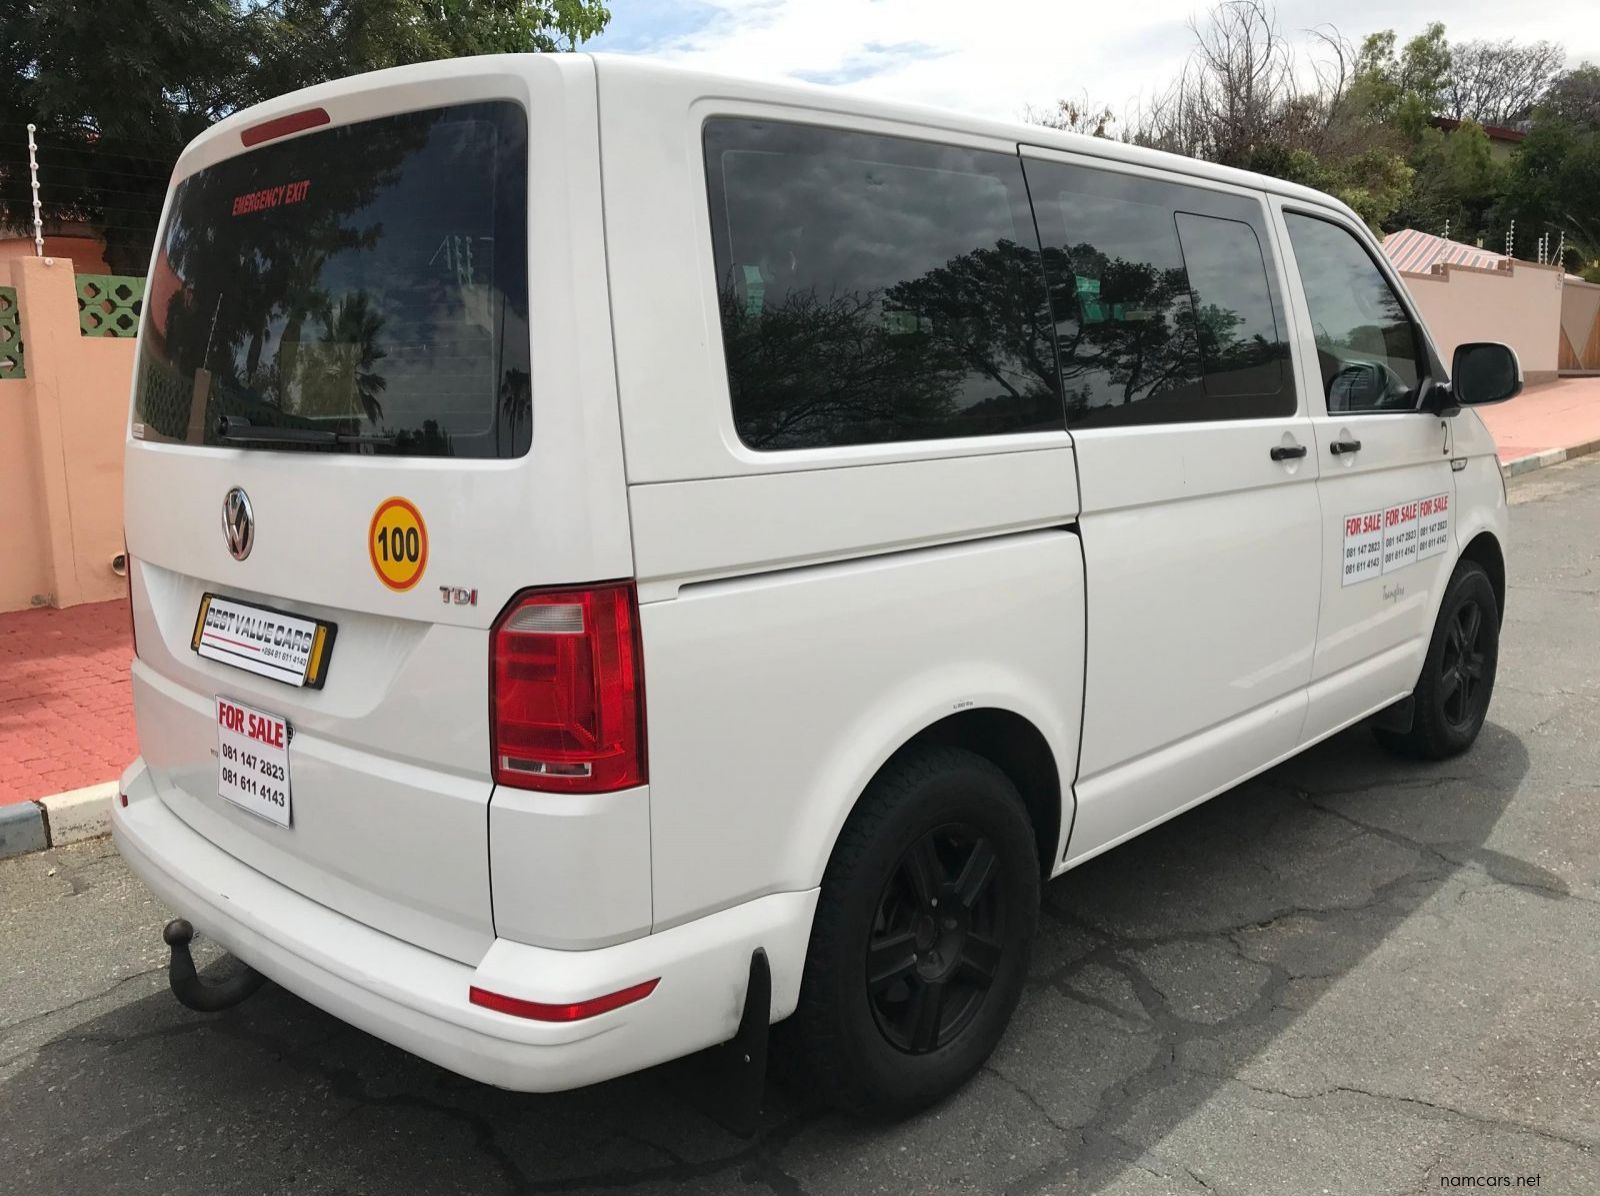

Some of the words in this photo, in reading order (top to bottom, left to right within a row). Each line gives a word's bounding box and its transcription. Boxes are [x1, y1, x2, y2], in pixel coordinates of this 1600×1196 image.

[232, 185, 286, 216] EMERGENCY
[285, 180, 311, 204] EXIT
[1386, 508, 1399, 527] FOR
[1401, 503, 1417, 522] SALE
[1420, 501, 1433, 518] FOR
[1434, 496, 1448, 513] SALE
[1346, 517, 1361, 536] FOR
[1363, 513, 1381, 533] SALE
[378, 527, 420, 563] 100
[1346, 547, 1356, 558] 081
[1358, 544, 1367, 555] 147
[1368, 541, 1381, 553] 2823
[1385, 536, 1394, 548] 081
[1396, 533, 1405, 543] 147
[1405, 530, 1417, 541] 2823
[1385, 552, 1394, 563] 081
[1395, 549, 1404, 560] 611
[1404, 545, 1416, 556] 4143
[1345, 563, 1355, 575] 081
[1357, 560, 1366, 572] 611
[1367, 557, 1380, 568] 4143
[439, 586, 478, 607] TDI
[206, 607, 235, 633] BEST
[235, 615, 275, 643] VALUE
[274, 626, 312, 654] CARS
[275, 650, 281, 659] 81
[282, 652, 292, 663] 611
[293, 655, 307, 667] 4143
[219, 702, 244, 734] FOR
[248, 713, 284, 748] SALE
[222, 743, 237, 762] 081
[241, 752, 257, 770] 147
[260, 759, 284, 781] 2823
[222, 767, 237, 786] 081
[241, 775, 256, 795] 611
[260, 784, 284, 807] 4143
